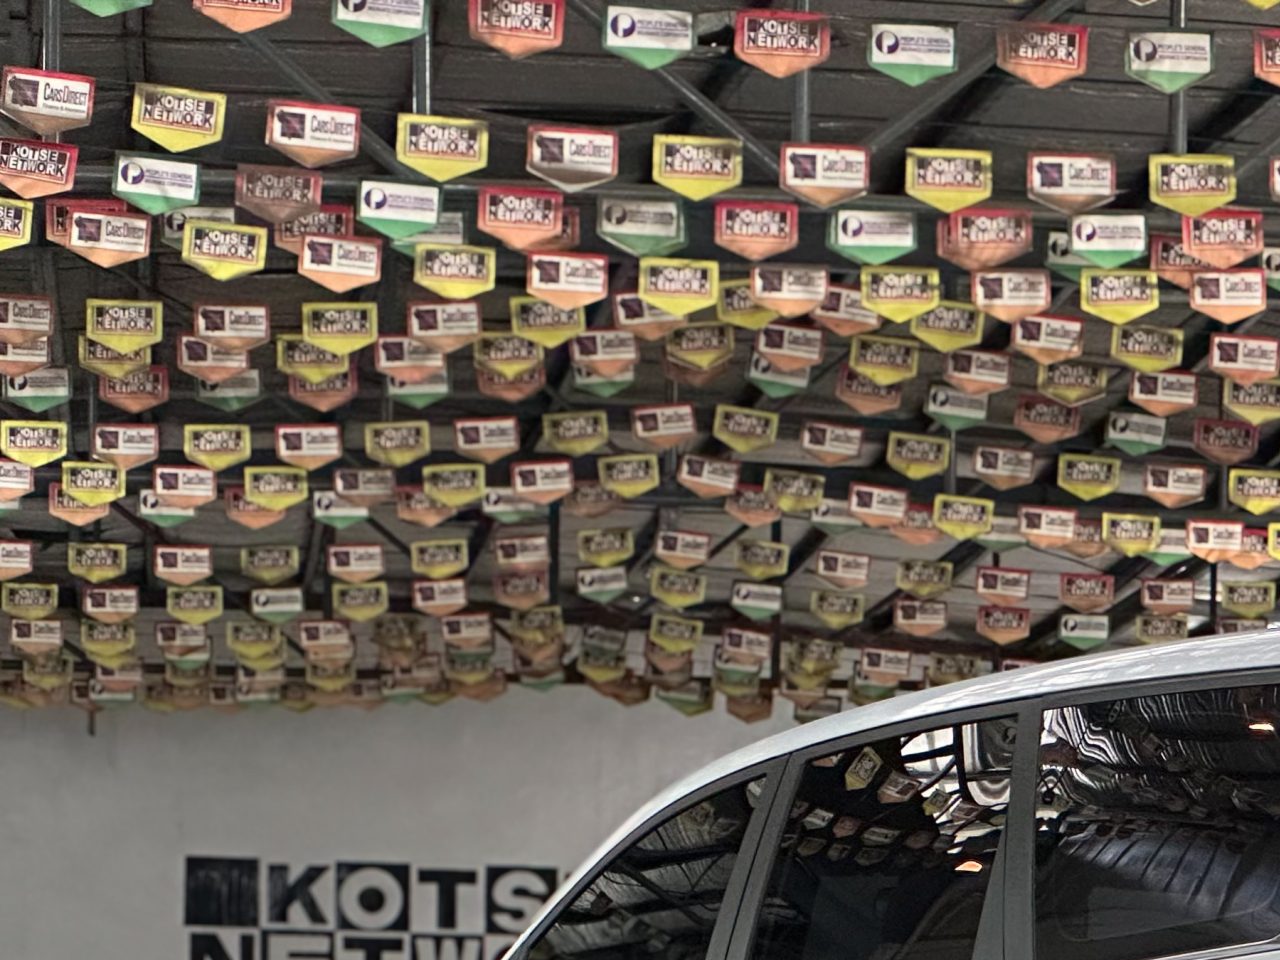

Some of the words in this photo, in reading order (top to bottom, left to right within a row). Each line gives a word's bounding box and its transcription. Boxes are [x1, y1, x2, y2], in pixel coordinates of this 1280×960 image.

[492, 0, 544, 14] KOTSE
[482, 12, 551, 30] NETWORK
[759, 19, 809, 35] KOTSE
[747, 31, 819, 49] NETWORK
[43, 82, 87, 106] CARSDIRECT
[156, 95, 205, 113] KOTSE
[143, 105, 213, 128] NETWORK
[419, 125, 470, 139] KOTSE
[11, 145, 58, 163] KOTSE
[409, 136, 477, 154] NETWORK
[0, 155, 64, 177] NETWORK
[498, 196, 544, 211] KOTSE
[489, 206, 552, 223] NETWORK
[208, 230, 248, 245] KOTSE
[195, 240, 254, 259] NETWORK
[266, 864, 570, 934] KOTS
